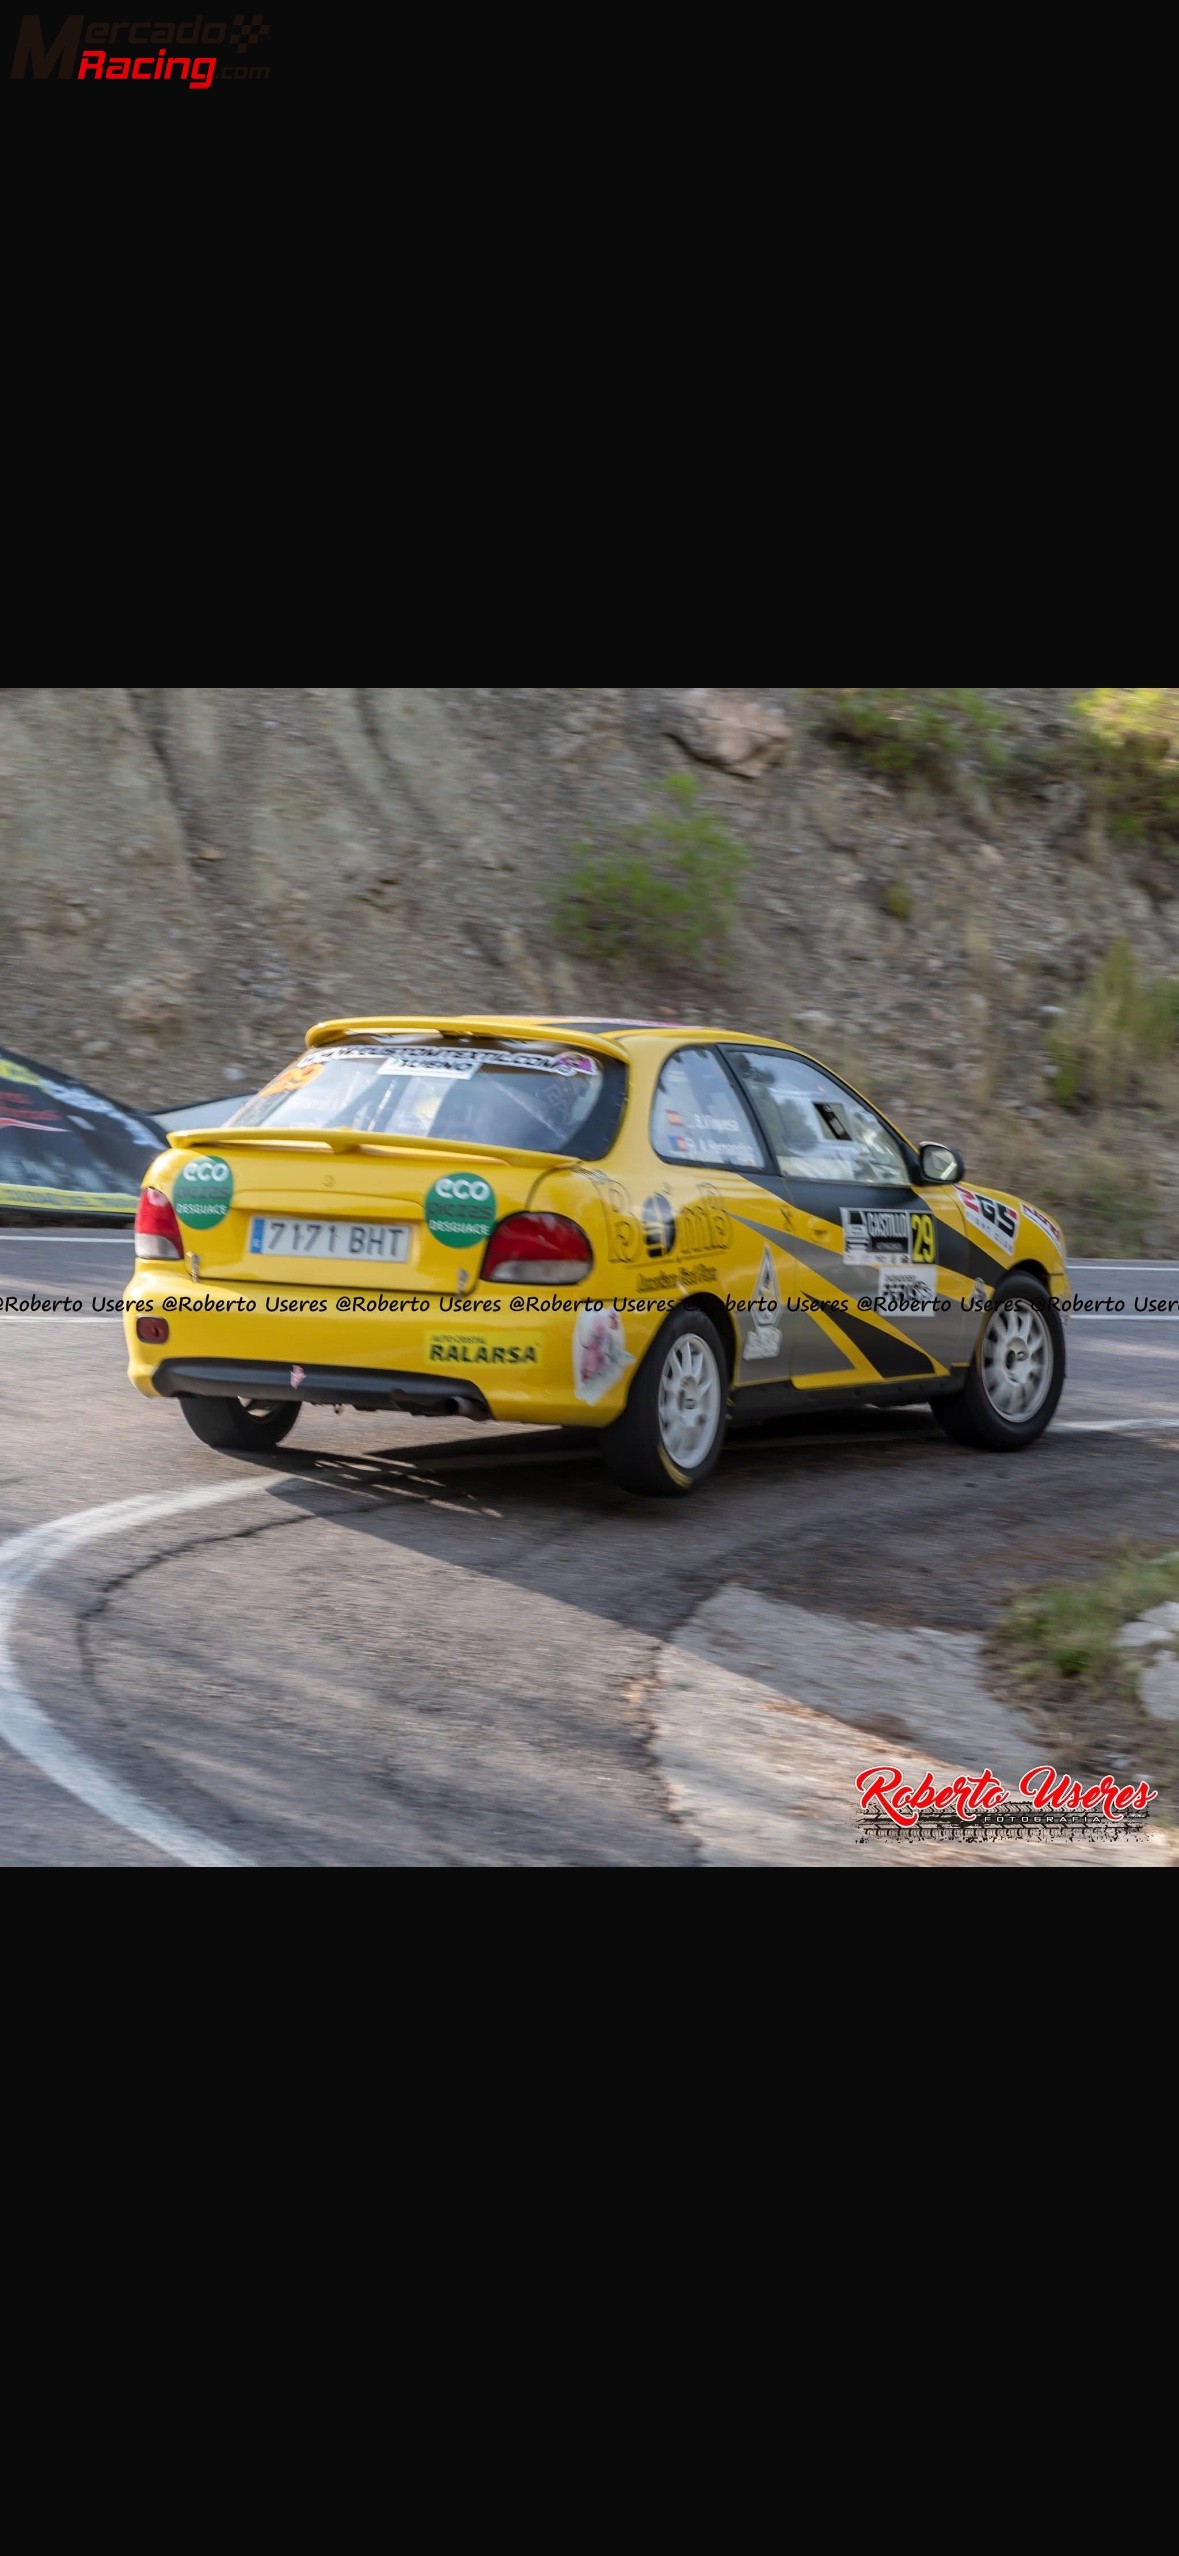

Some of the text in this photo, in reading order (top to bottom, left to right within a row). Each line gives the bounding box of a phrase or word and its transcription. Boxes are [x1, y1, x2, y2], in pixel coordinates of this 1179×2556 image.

[434, 1177, 491, 1201] eco
[268, 1222, 404, 1257] 7171 BHT
[911, 1213, 936, 1263] 29
[430, 1344, 537, 1363] RALARSA
